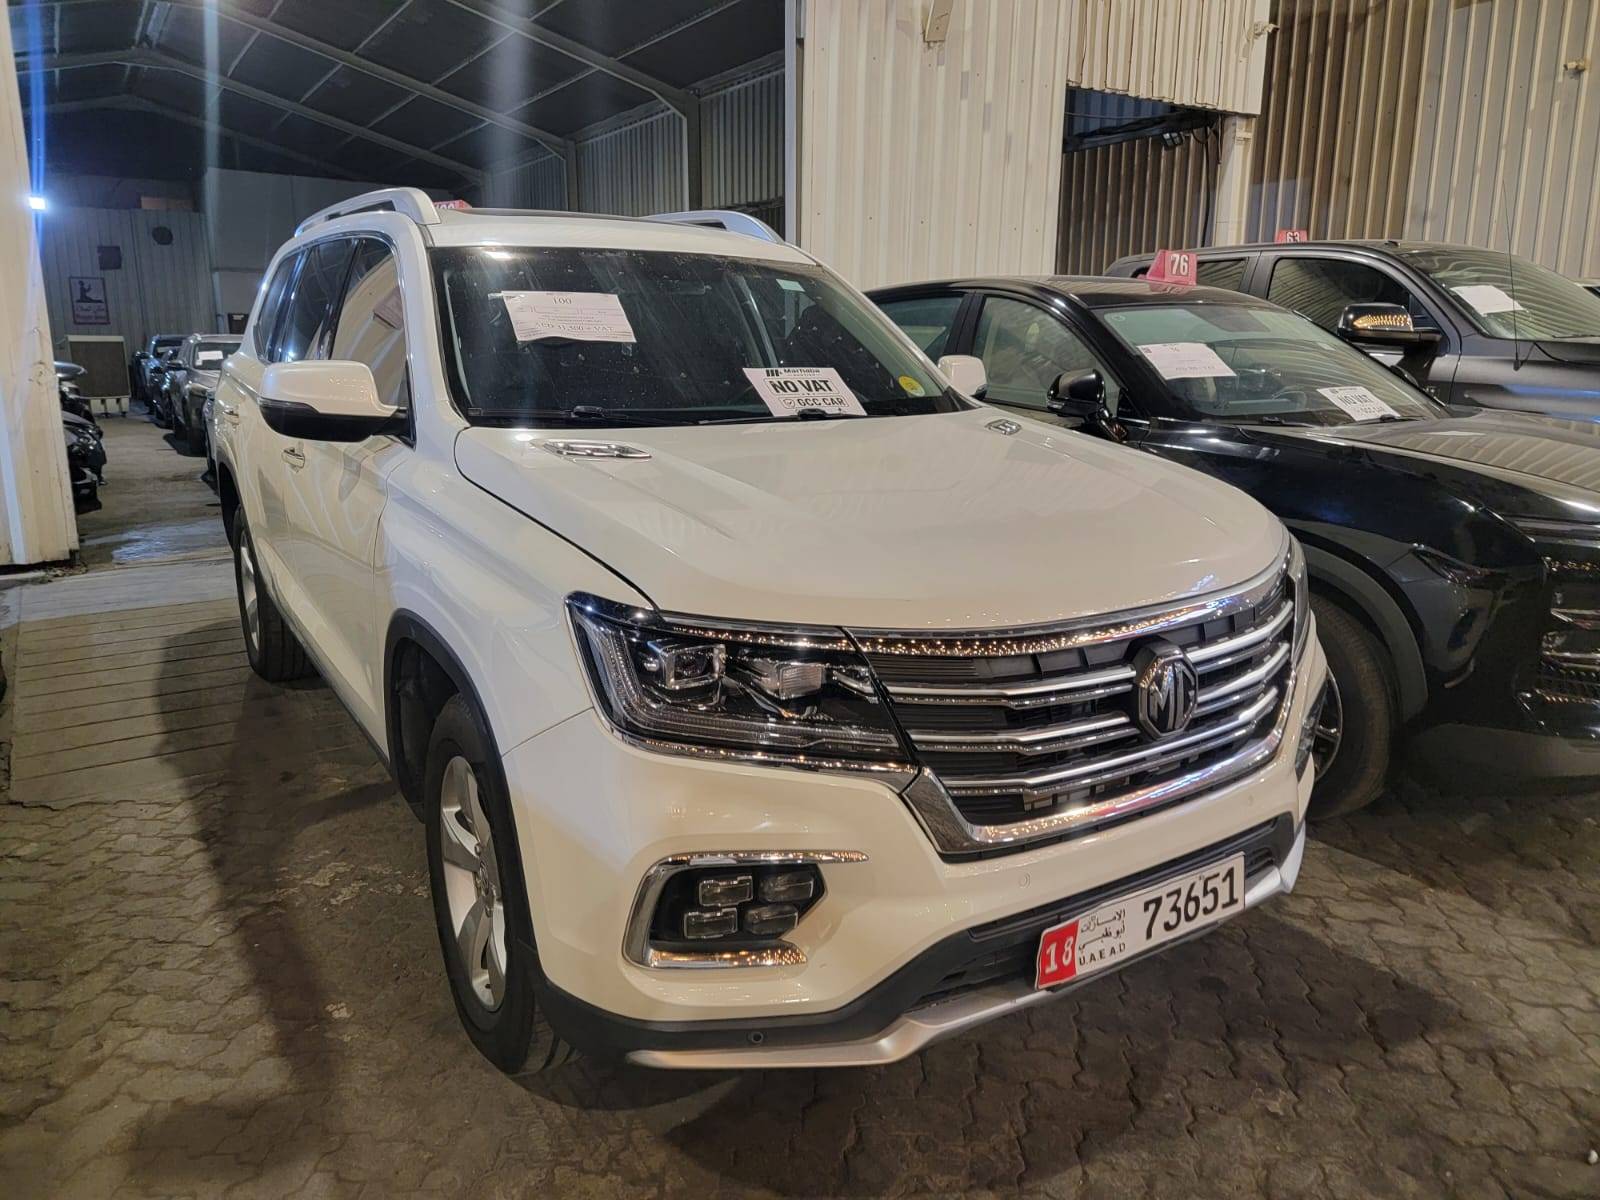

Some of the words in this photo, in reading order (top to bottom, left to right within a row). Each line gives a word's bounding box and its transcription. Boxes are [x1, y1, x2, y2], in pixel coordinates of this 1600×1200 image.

[1286, 231, 1300, 243] 63
[1170, 254, 1188, 276] 76
[552, 297, 572, 305] 100
[768, 380, 799, 393] NO
[797, 380, 834, 393] VAT
[796, 398, 822, 407] GCC
[822, 397, 846, 407] CAR
[1143, 866, 1239, 941] 73651
[1044, 935, 1074, 974] 18
